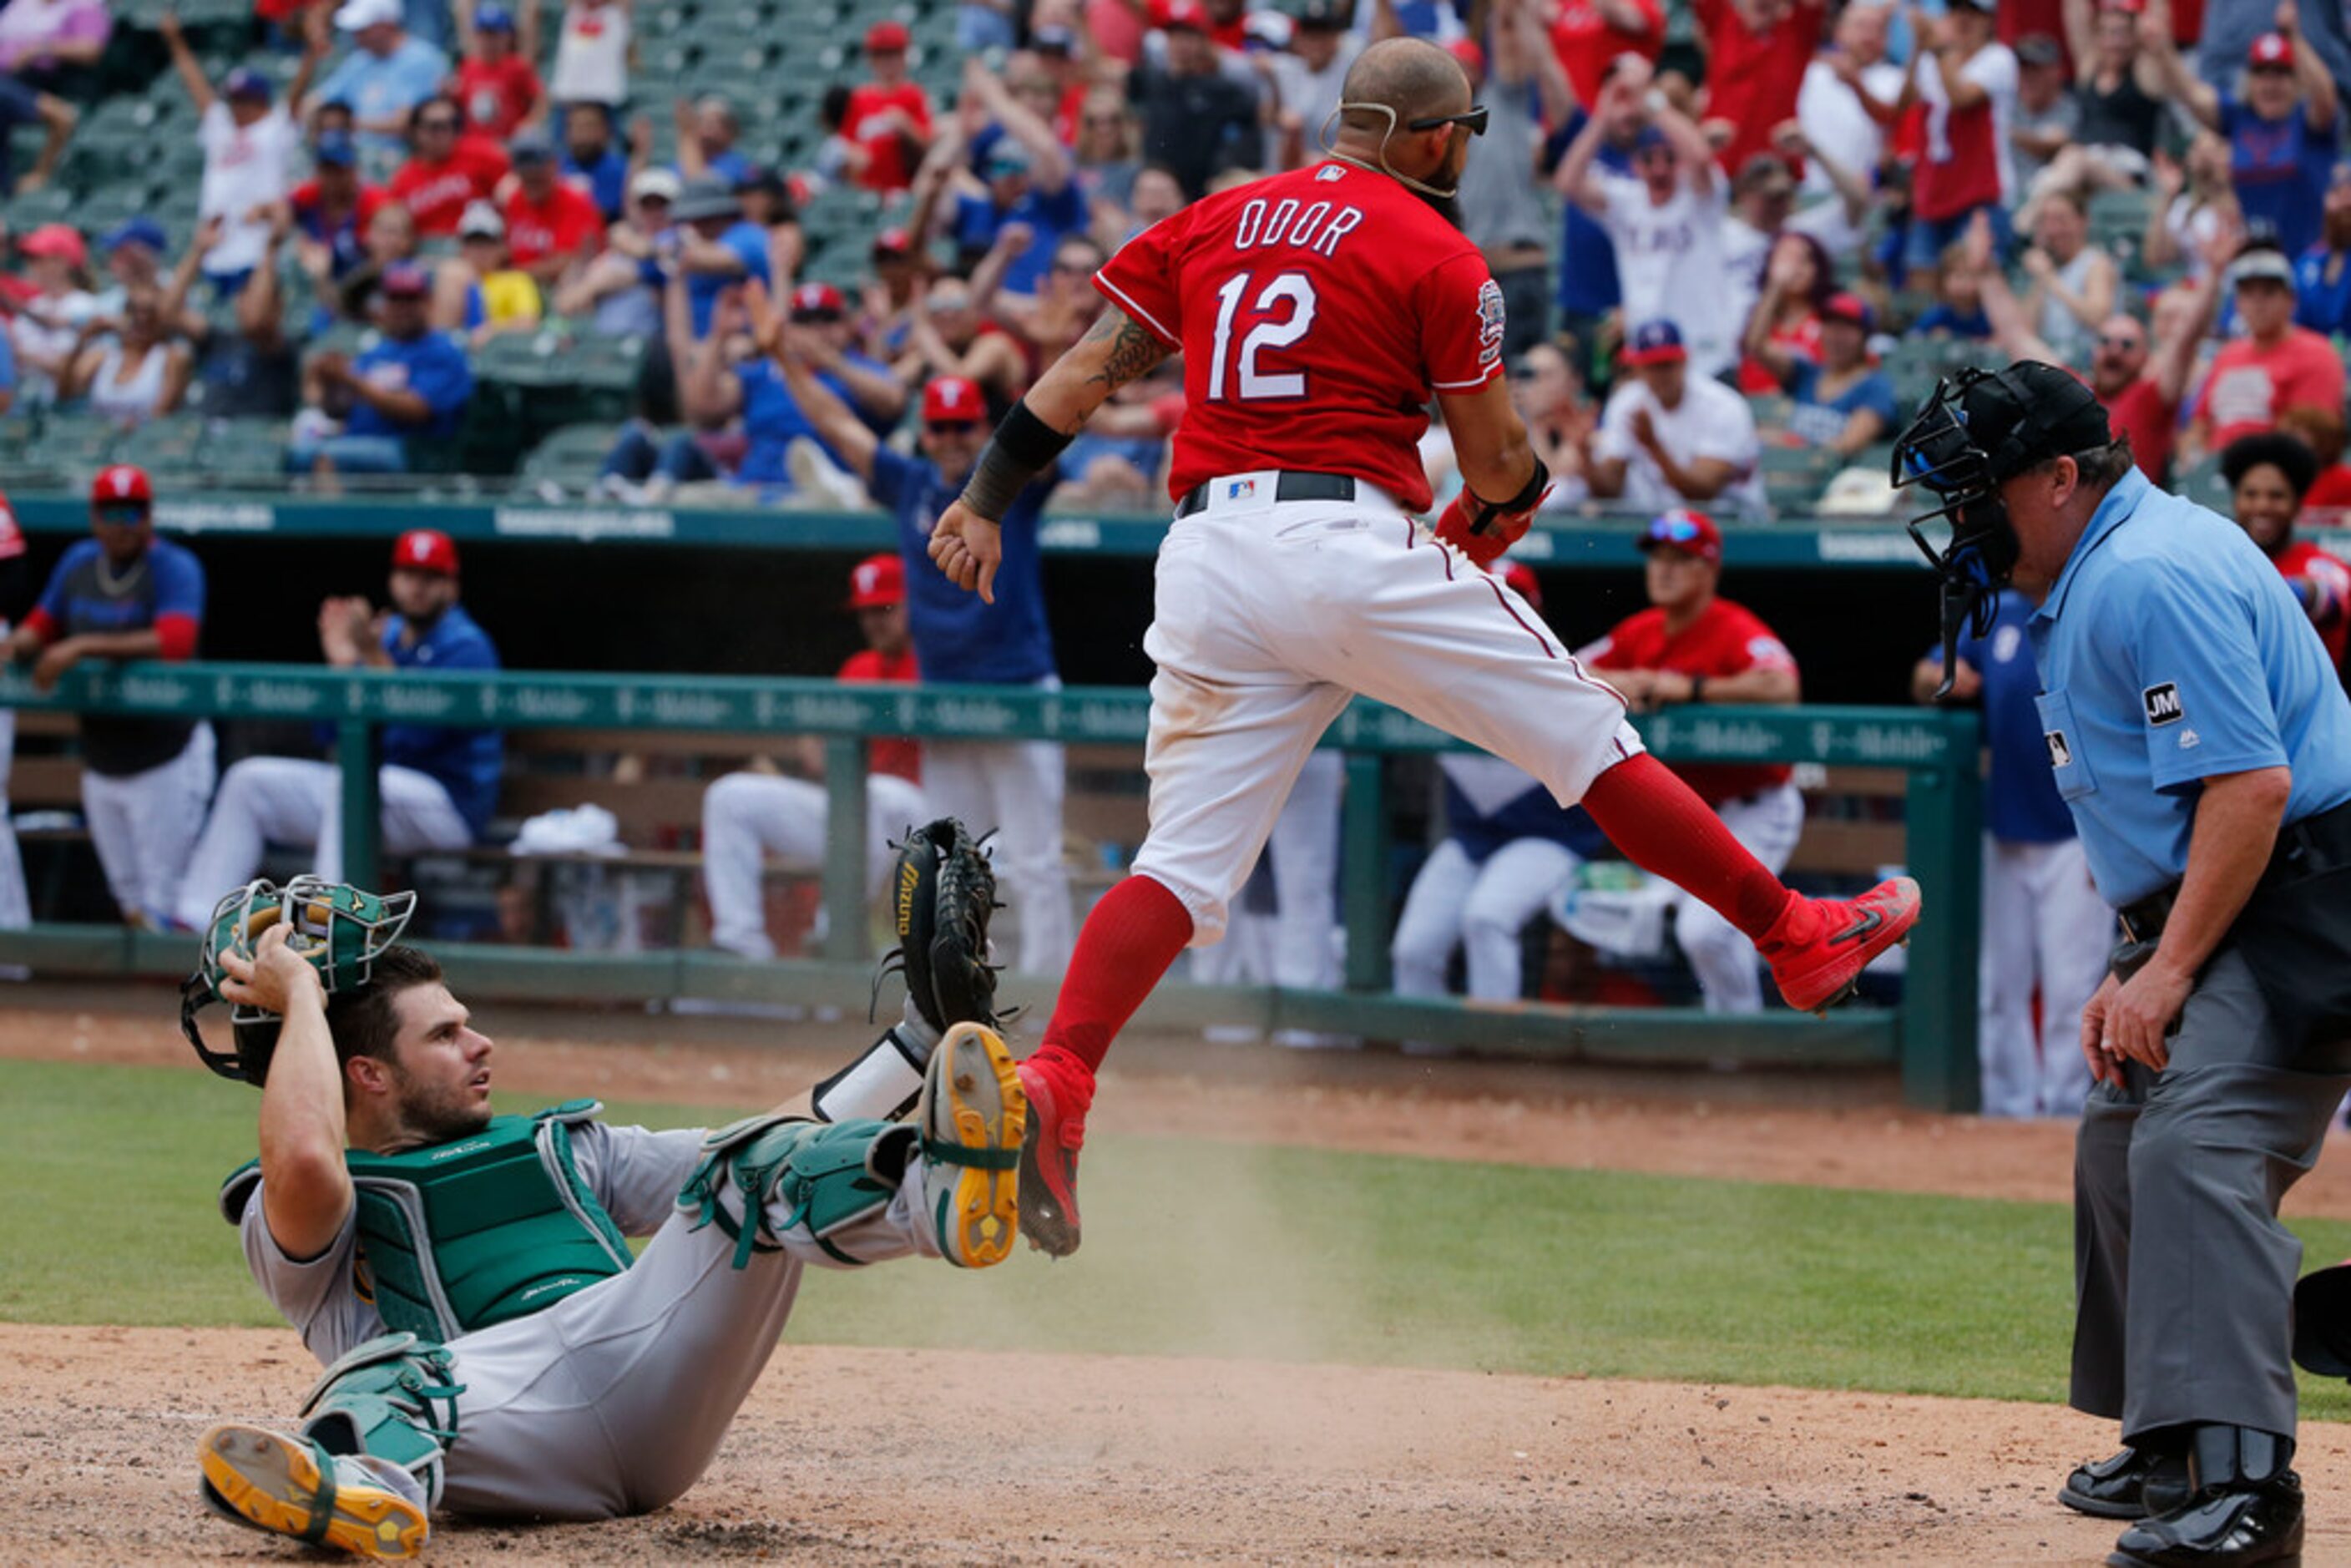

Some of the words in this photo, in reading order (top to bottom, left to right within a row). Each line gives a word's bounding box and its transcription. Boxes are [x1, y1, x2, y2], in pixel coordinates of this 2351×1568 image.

[1235, 198, 1363, 258] ODOR
[1206, 271, 1317, 402] 12
[2148, 690, 2180, 717] JM
